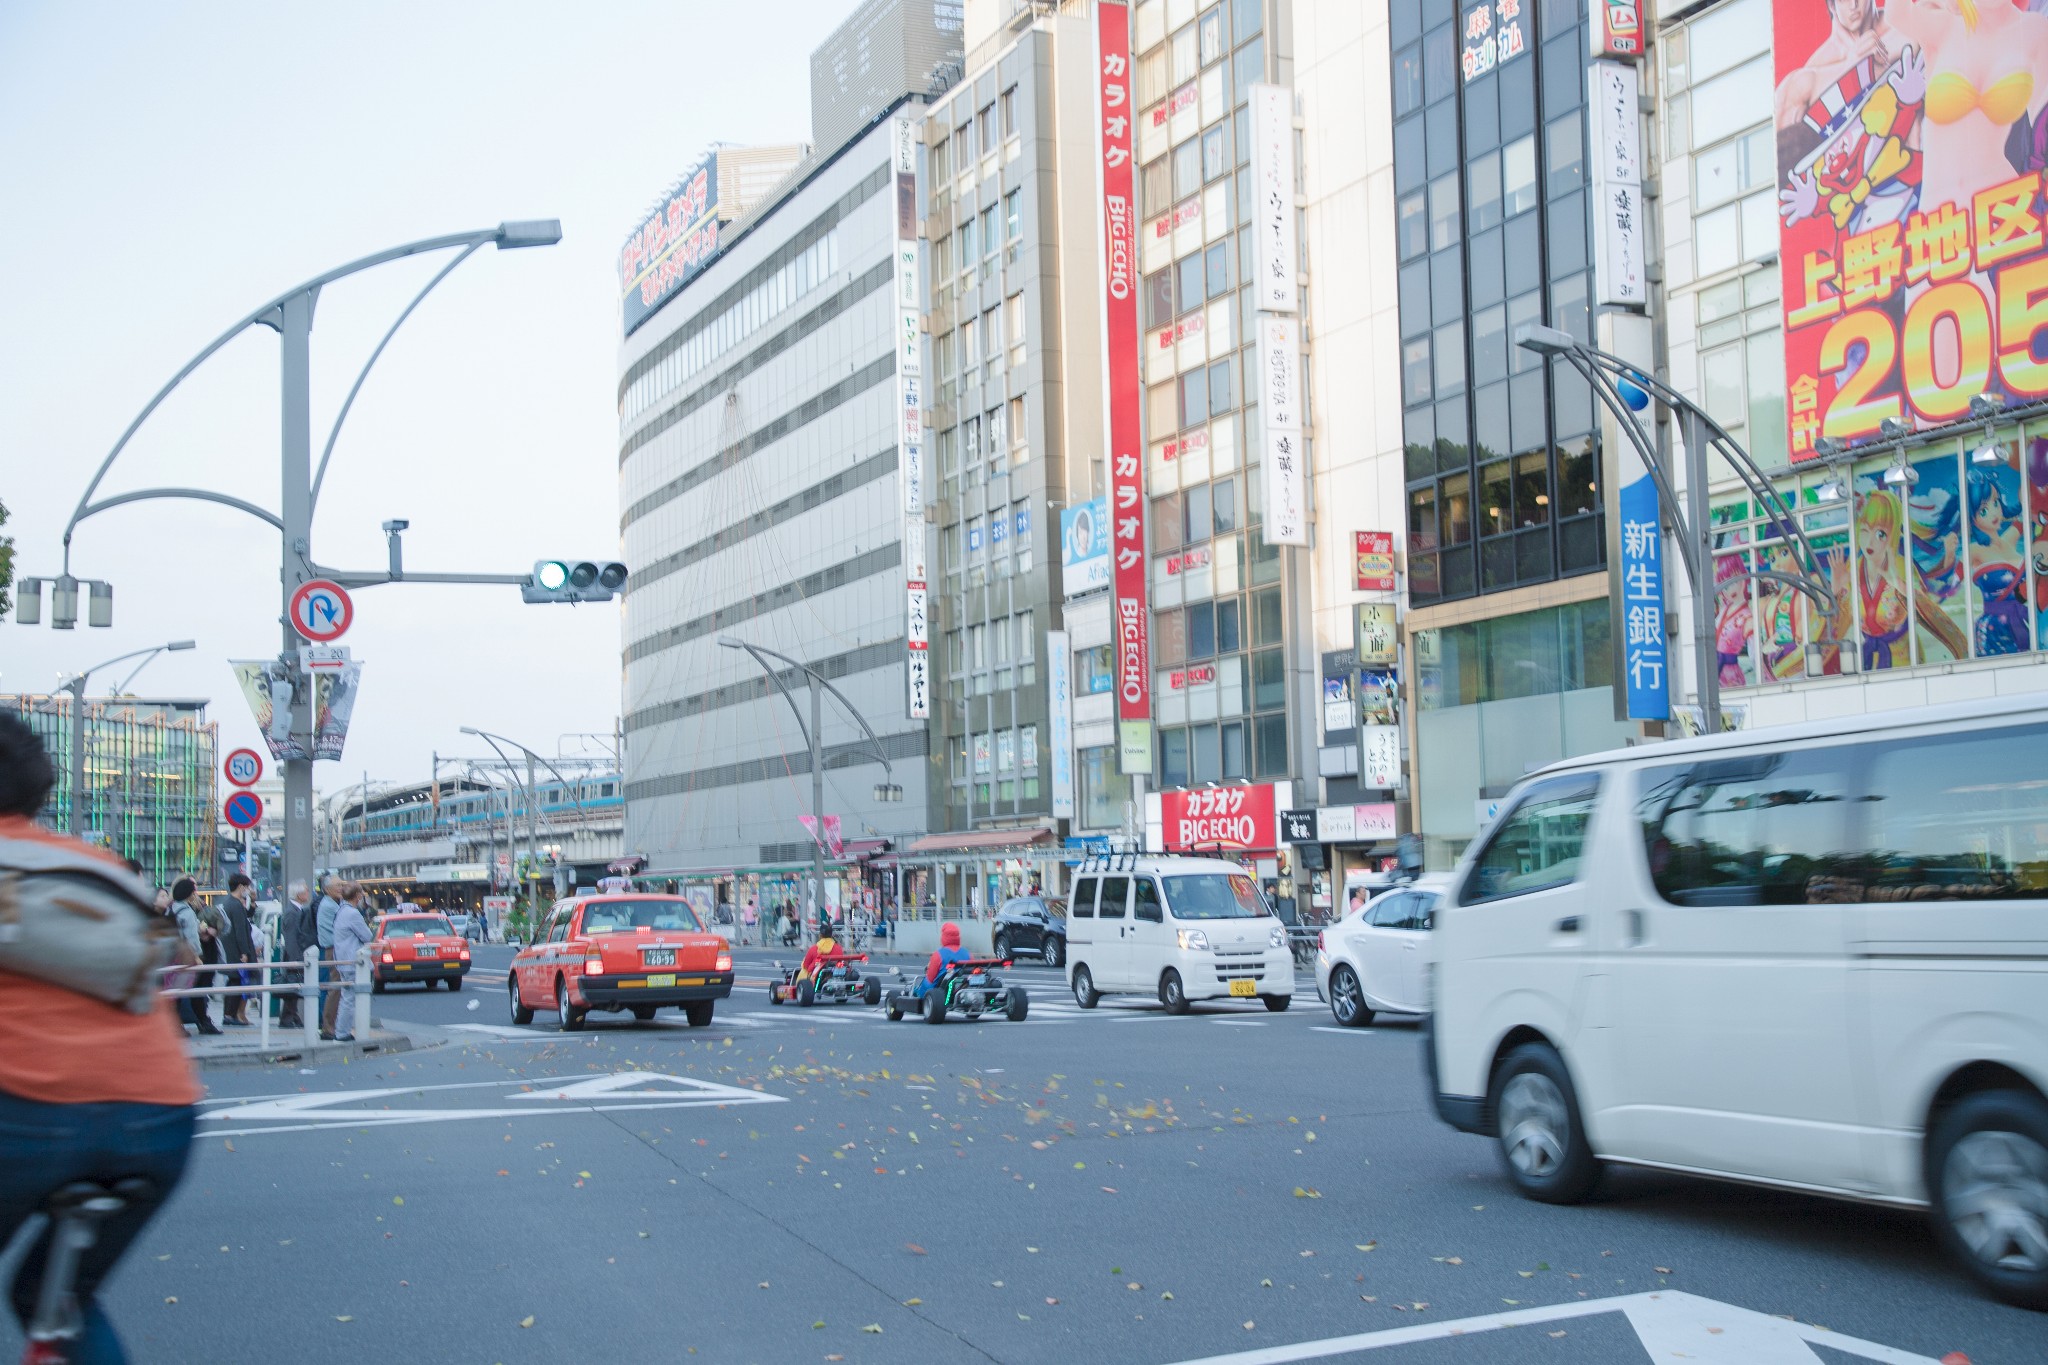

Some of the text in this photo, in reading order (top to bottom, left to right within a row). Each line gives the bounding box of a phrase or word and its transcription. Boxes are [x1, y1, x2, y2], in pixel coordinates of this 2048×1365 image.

[1463, 21, 1524, 81] ウェルカム
[1104, 53, 1129, 169] カラオケ
[1107, 194, 1129, 300] BIG ECHO
[1787, 174, 2048, 329] 上野地区
[1790, 374, 1820, 452] 合計
[1115, 453, 1142, 570] カラオケ
[910, 593, 923, 636] マスヤ
[1119, 597, 1142, 704] BIG ECHO
[1624, 519, 1662, 691] 新生銀行
[232, 759, 255, 776] 50
[1187, 788, 1245, 817] カラオケ
[1179, 814, 1255, 848] BIG ECHO
